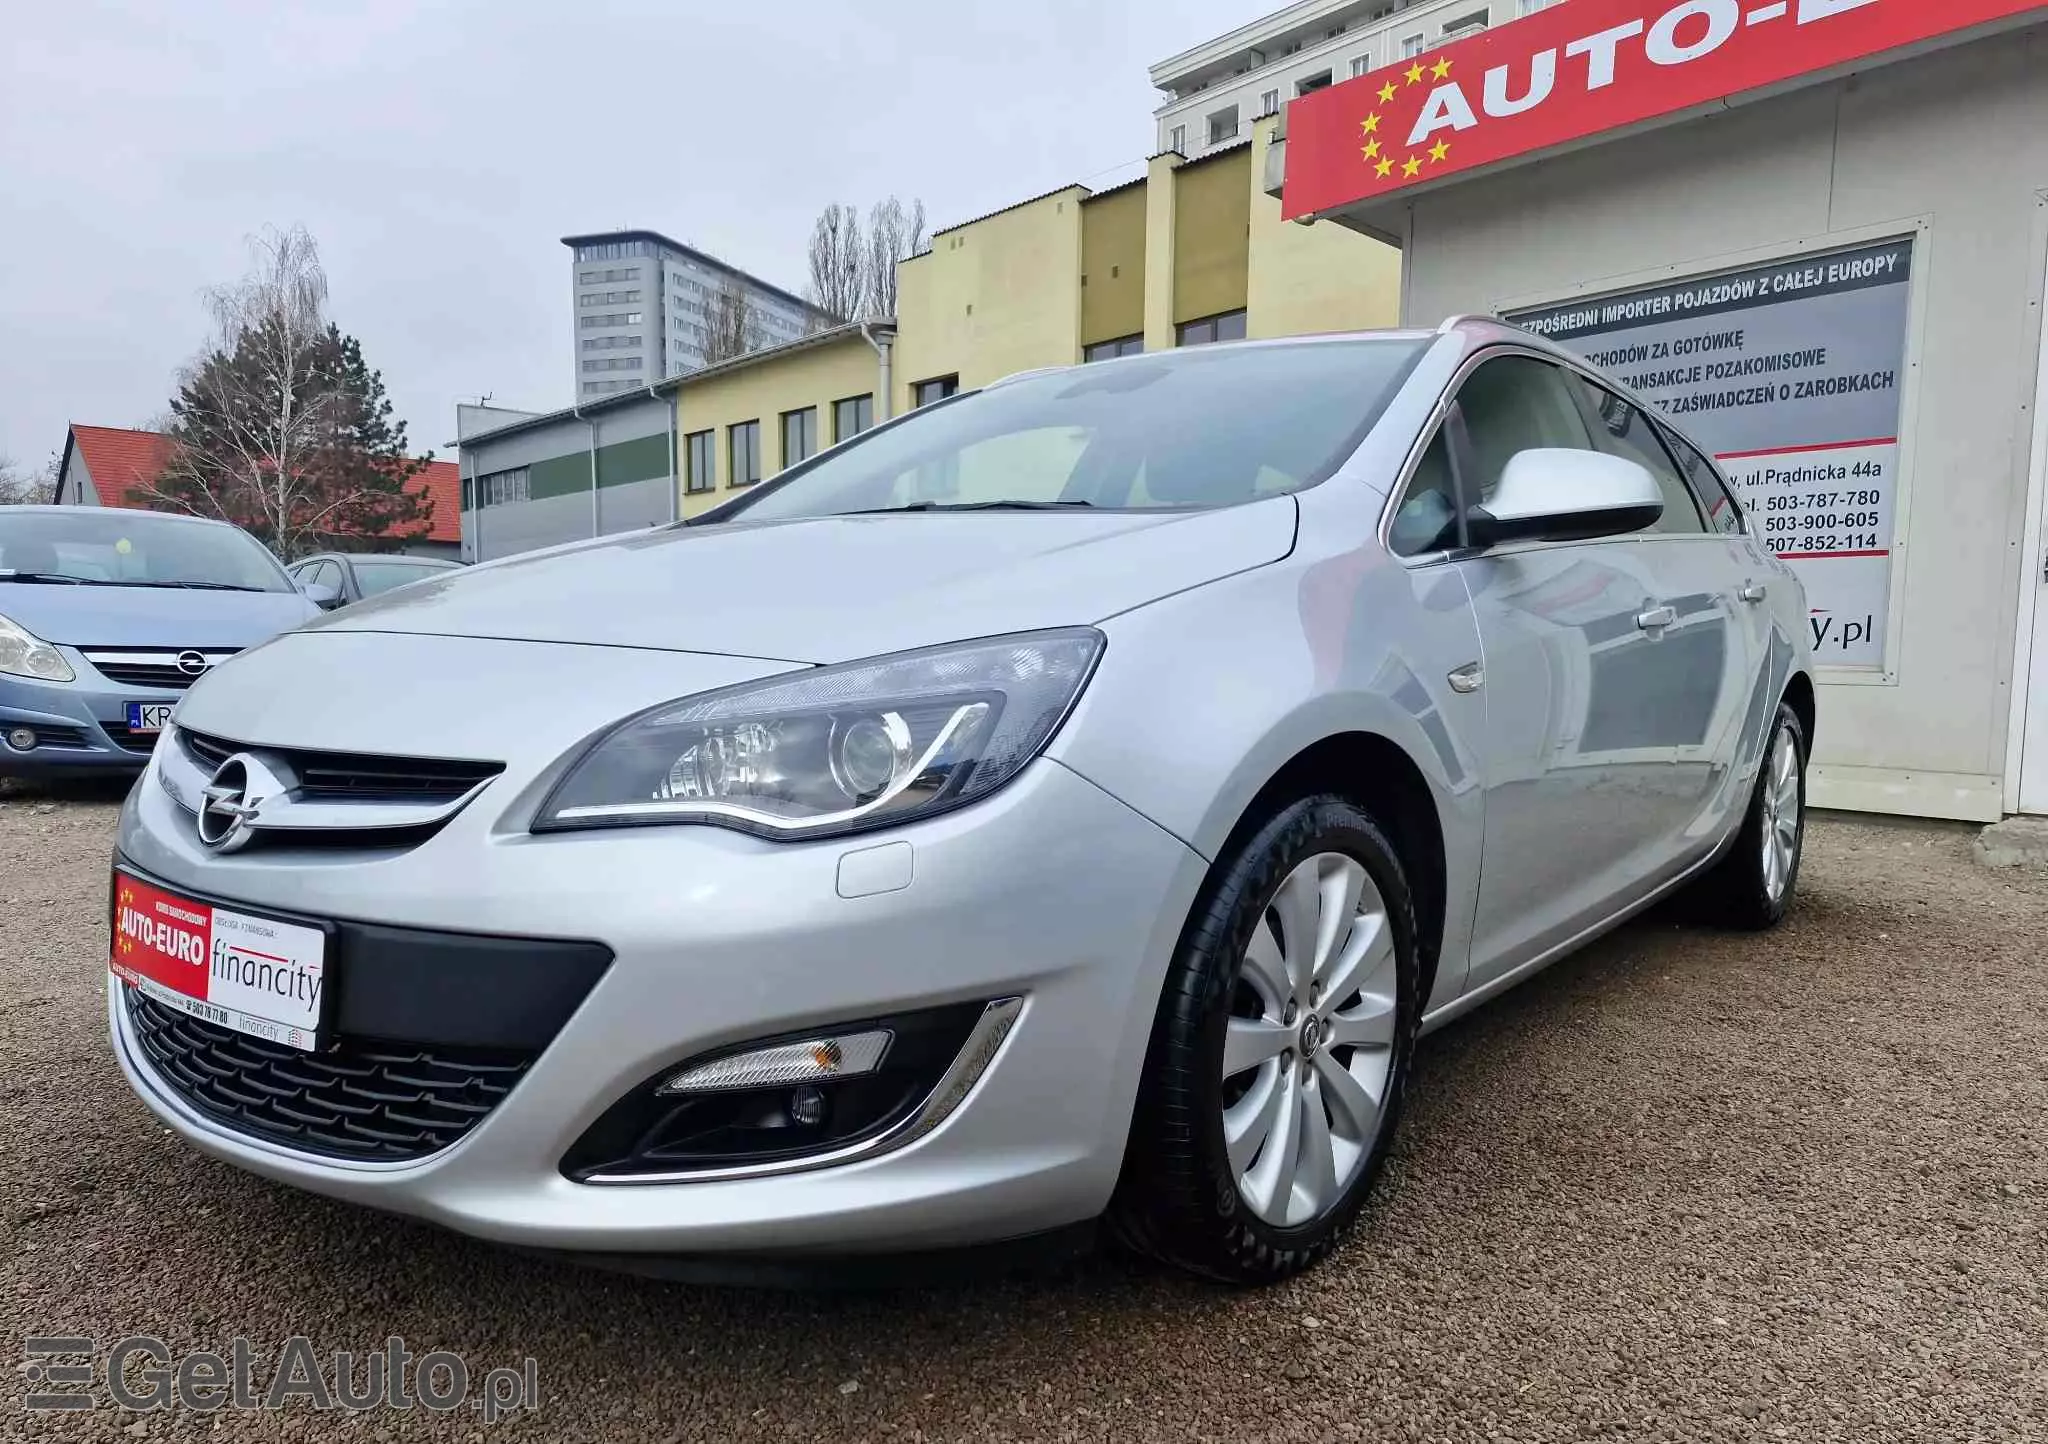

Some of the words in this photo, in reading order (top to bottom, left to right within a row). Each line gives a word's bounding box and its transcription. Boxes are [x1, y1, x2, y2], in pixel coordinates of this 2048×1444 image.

[1602, 295, 1671, 323] IMPORTER
[1674, 279, 1756, 311] POJAZDÓW
[1758, 278, 1769, 295] Z
[1773, 267, 1824, 293] CAŁEJ
[1828, 253, 1898, 283] EUROPY
[1651, 342, 1669, 359] ZA
[1673, 330, 1744, 356] GOTÓWKĘ
[1706, 348, 1827, 381] POZAKOMISOWE
[1671, 382, 1775, 414] ZAŚWIADCZEŃ
[1779, 384, 1790, 401] O
[1794, 370, 1894, 399] ZAROBKACH
[1852, 460, 1882, 477] 44a
[1767, 489, 1880, 511] 503-787-780
[1766, 511, 1879, 532] 503-900-605
[1766, 533, 1877, 551] 507-852-114
[1810, 614, 1872, 651] y.pl
[121, 906, 204, 966] AUTO-EURO
[212, 938, 323, 1012] financity
[238, 1015, 279, 1042] financity
